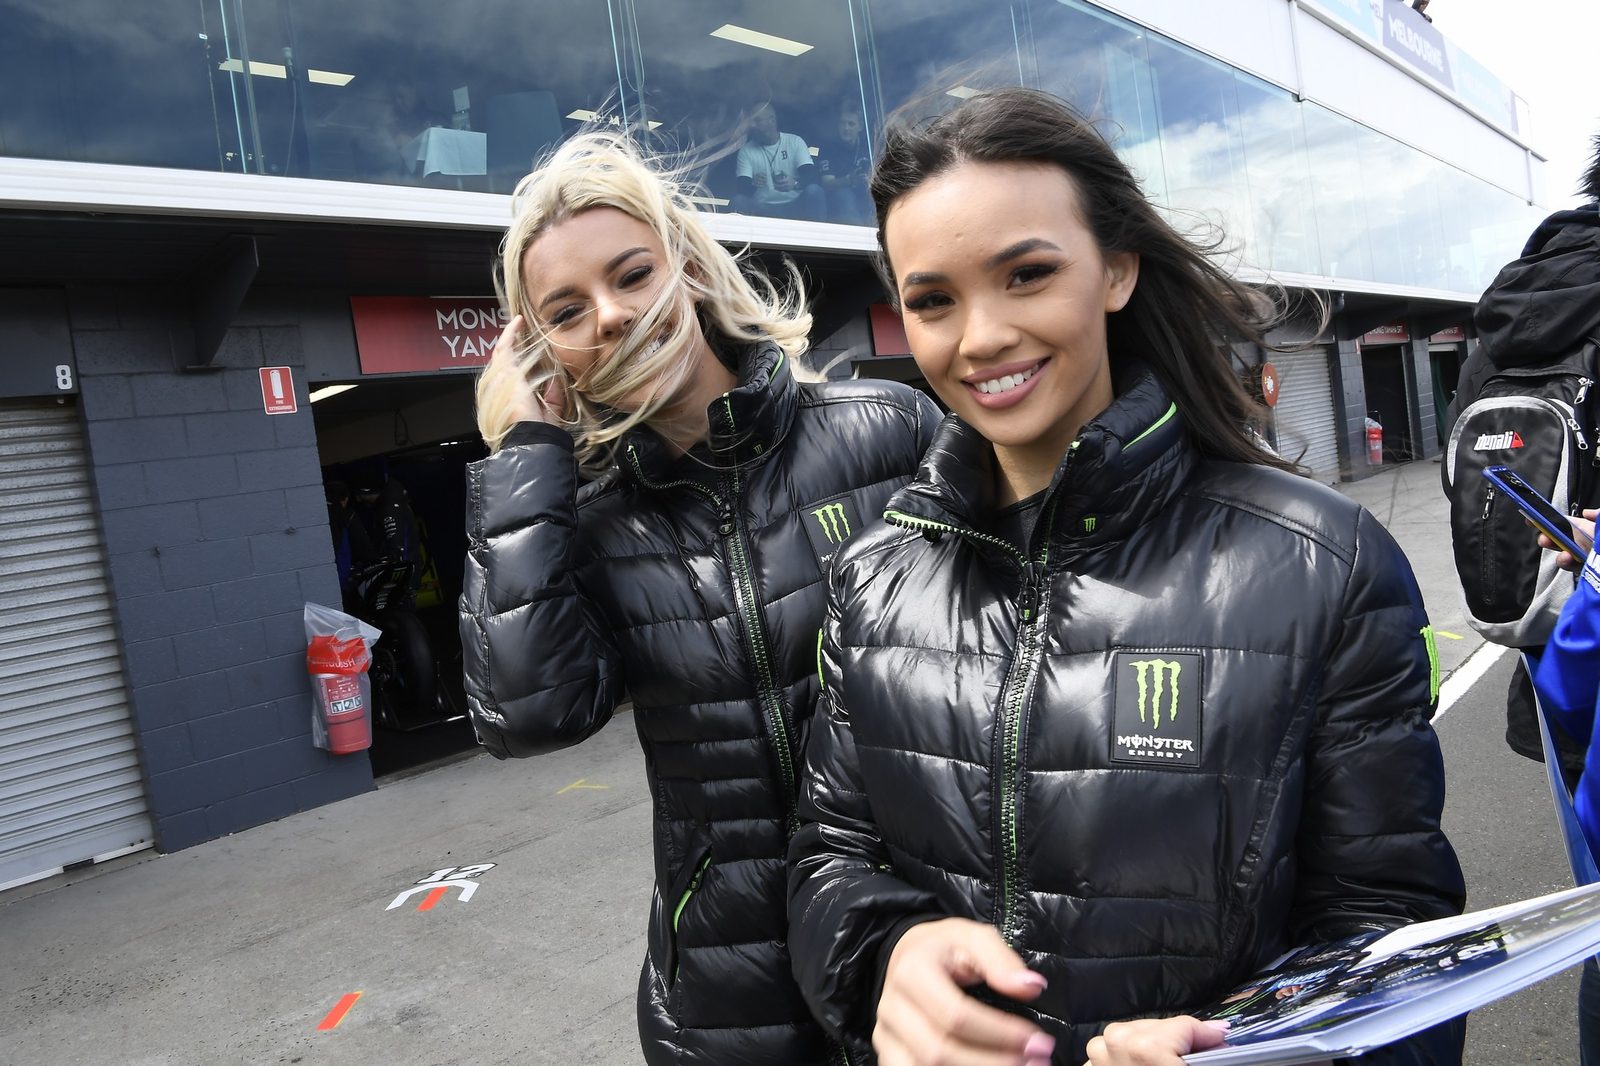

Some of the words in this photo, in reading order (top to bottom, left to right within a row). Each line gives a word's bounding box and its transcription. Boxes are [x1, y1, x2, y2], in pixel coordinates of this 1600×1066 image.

[435, 307, 510, 331] MONS
[442, 335, 499, 358] YAM
[56, 364, 73, 390] 8
[1474, 431, 1513, 451] denali
[1117, 734, 1195, 752] MONSTER
[1128, 749, 1183, 759] ENERGY
